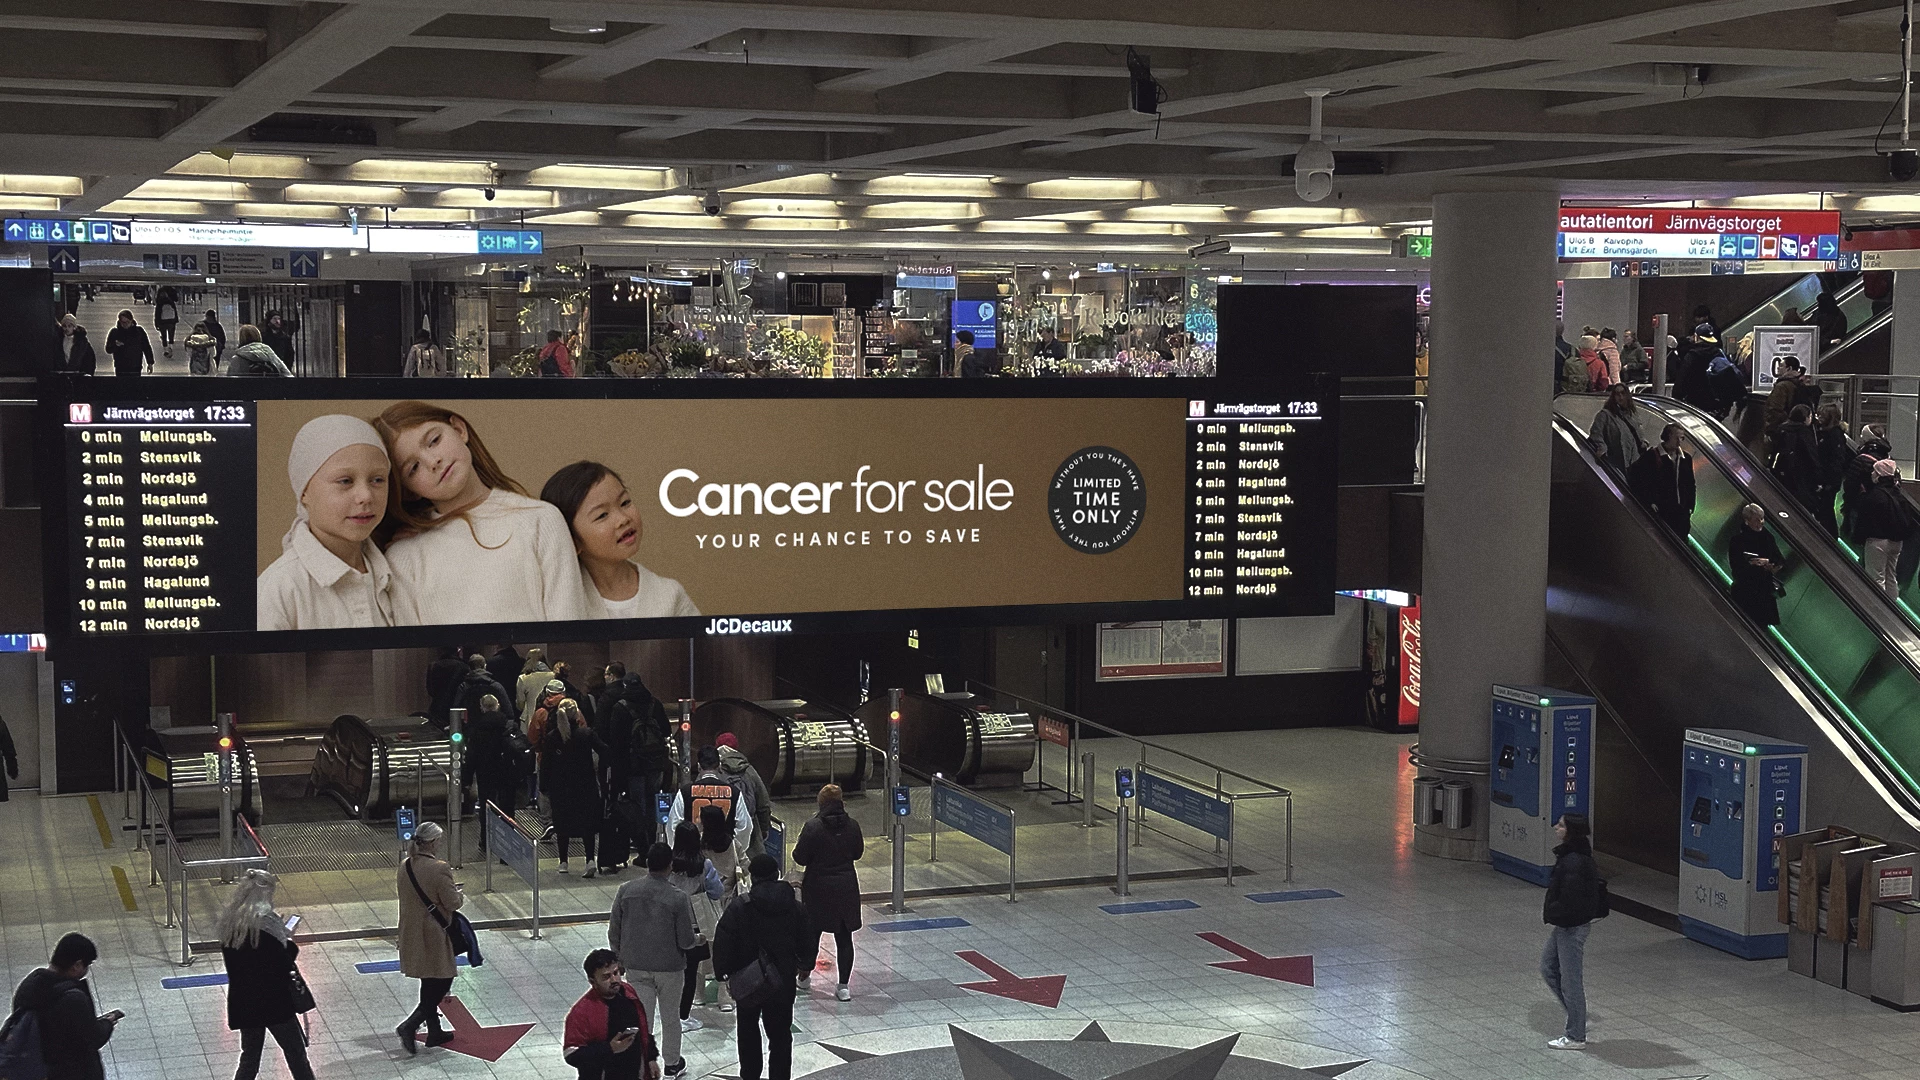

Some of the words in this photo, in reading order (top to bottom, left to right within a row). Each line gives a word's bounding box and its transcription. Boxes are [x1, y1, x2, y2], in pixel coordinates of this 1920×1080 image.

[1560, 213, 1653, 229] autatientori
[1665, 214, 1781, 233] Järnvägstorget
[1604, 237, 1643, 246] Kaivopiha
[1690, 238, 1707, 246] Ulos
[1568, 246, 1578, 254] Ut
[1580, 246, 1596, 254] Exit
[1688, 247, 1697, 255] Ut
[1700, 247, 1715, 255] Exit
[103, 407, 194, 422] Järnvägstorget
[204, 406, 245, 421] 17:33
[1213, 403, 1281, 415] Järnvägstorget
[1287, 402, 1318, 414] 17:33
[1197, 424, 1204, 434] 0
[1206, 424, 1226, 434] min
[1239, 423, 1296, 435] Mellungsb.
[81, 431, 91, 443] 0
[95, 431, 122, 443] min
[140, 431, 217, 444] Mellungsb.
[1196, 442, 1203, 452] 2
[1206, 442, 1226, 452] min
[1239, 441, 1284, 452] Stensvik
[82, 452, 92, 464] 2
[96, 452, 123, 464] min
[140, 451, 202, 463] Stensvik
[1196, 460, 1203, 470] 2
[1206, 460, 1226, 470] min
[1238, 459, 1280, 471] Nordsjö
[82, 473, 92, 485] 2
[96, 473, 123, 485] min
[141, 472, 197, 486] Nordsjö
[1055, 456, 1083, 489] WITHOUT
[1107, 454, 1127, 468] THEY
[1127, 469, 1139, 491] HAVE
[1073, 478, 1121, 488] LIMITED
[1195, 478, 1203, 488] 4
[1205, 478, 1225, 488] min
[1238, 477, 1287, 489] Hagalund
[659, 468, 844, 517] Cancer
[851, 465, 917, 513] for
[923, 463, 1015, 512] sale
[83, 494, 93, 506] 4
[97, 494, 124, 506] min
[142, 493, 208, 507] Hagalund
[1073, 491, 1120, 506] TIME
[1195, 496, 1203, 506] 5
[1205, 496, 1225, 506] min
[1238, 495, 1294, 507] Mellungsb.
[84, 515, 94, 527] 5
[98, 515, 125, 527] min
[143, 514, 219, 528] Mellungsb.
[1053, 508, 1067, 531] HAVE
[1072, 509, 1121, 524] ONLY
[1195, 514, 1202, 524] 7
[1205, 514, 1225, 524] min
[1237, 513, 1283, 524] Stensvik
[1112, 509, 1139, 544] WITHOUT
[84, 536, 94, 548] 7
[98, 536, 125, 548] min
[143, 535, 204, 547] Stensvik
[695, 534, 760, 549] YOUR
[774, 530, 871, 547] CHANCE
[883, 529, 912, 545] TO
[925, 528, 980, 544] SAVE
[1069, 533, 1088, 547] THEY
[1195, 532, 1202, 542] 7
[1204, 532, 1224, 542] min
[1237, 531, 1278, 542] Nordsjö
[1092, 541, 1110, 549] YOU
[1194, 550, 1201, 560] 9
[1204, 550, 1224, 560] min
[1237, 548, 1285, 560] Hagalund
[85, 557, 95, 569] 7
[99, 557, 126, 569] min
[143, 555, 199, 569] Nordsjö
[1188, 568, 1201, 578] 10
[1204, 568, 1224, 578] min
[1236, 566, 1293, 578] Mellungsb.
[86, 578, 95, 590] 9
[99, 578, 126, 590] min
[144, 576, 210, 590] Hagalund
[1188, 586, 1201, 596] 12
[1203, 586, 1223, 596] min
[1236, 584, 1277, 596] Nordsjö
[79, 599, 96, 611] 10
[100, 599, 127, 611] min
[145, 596, 221, 610] Mellungsb.
[80, 620, 96, 632] 12
[100, 619, 127, 632] min
[145, 617, 201, 631] Nordsjö
[705, 618, 792, 635] JCDecaux
[691, 784, 732, 798] NARUTO
